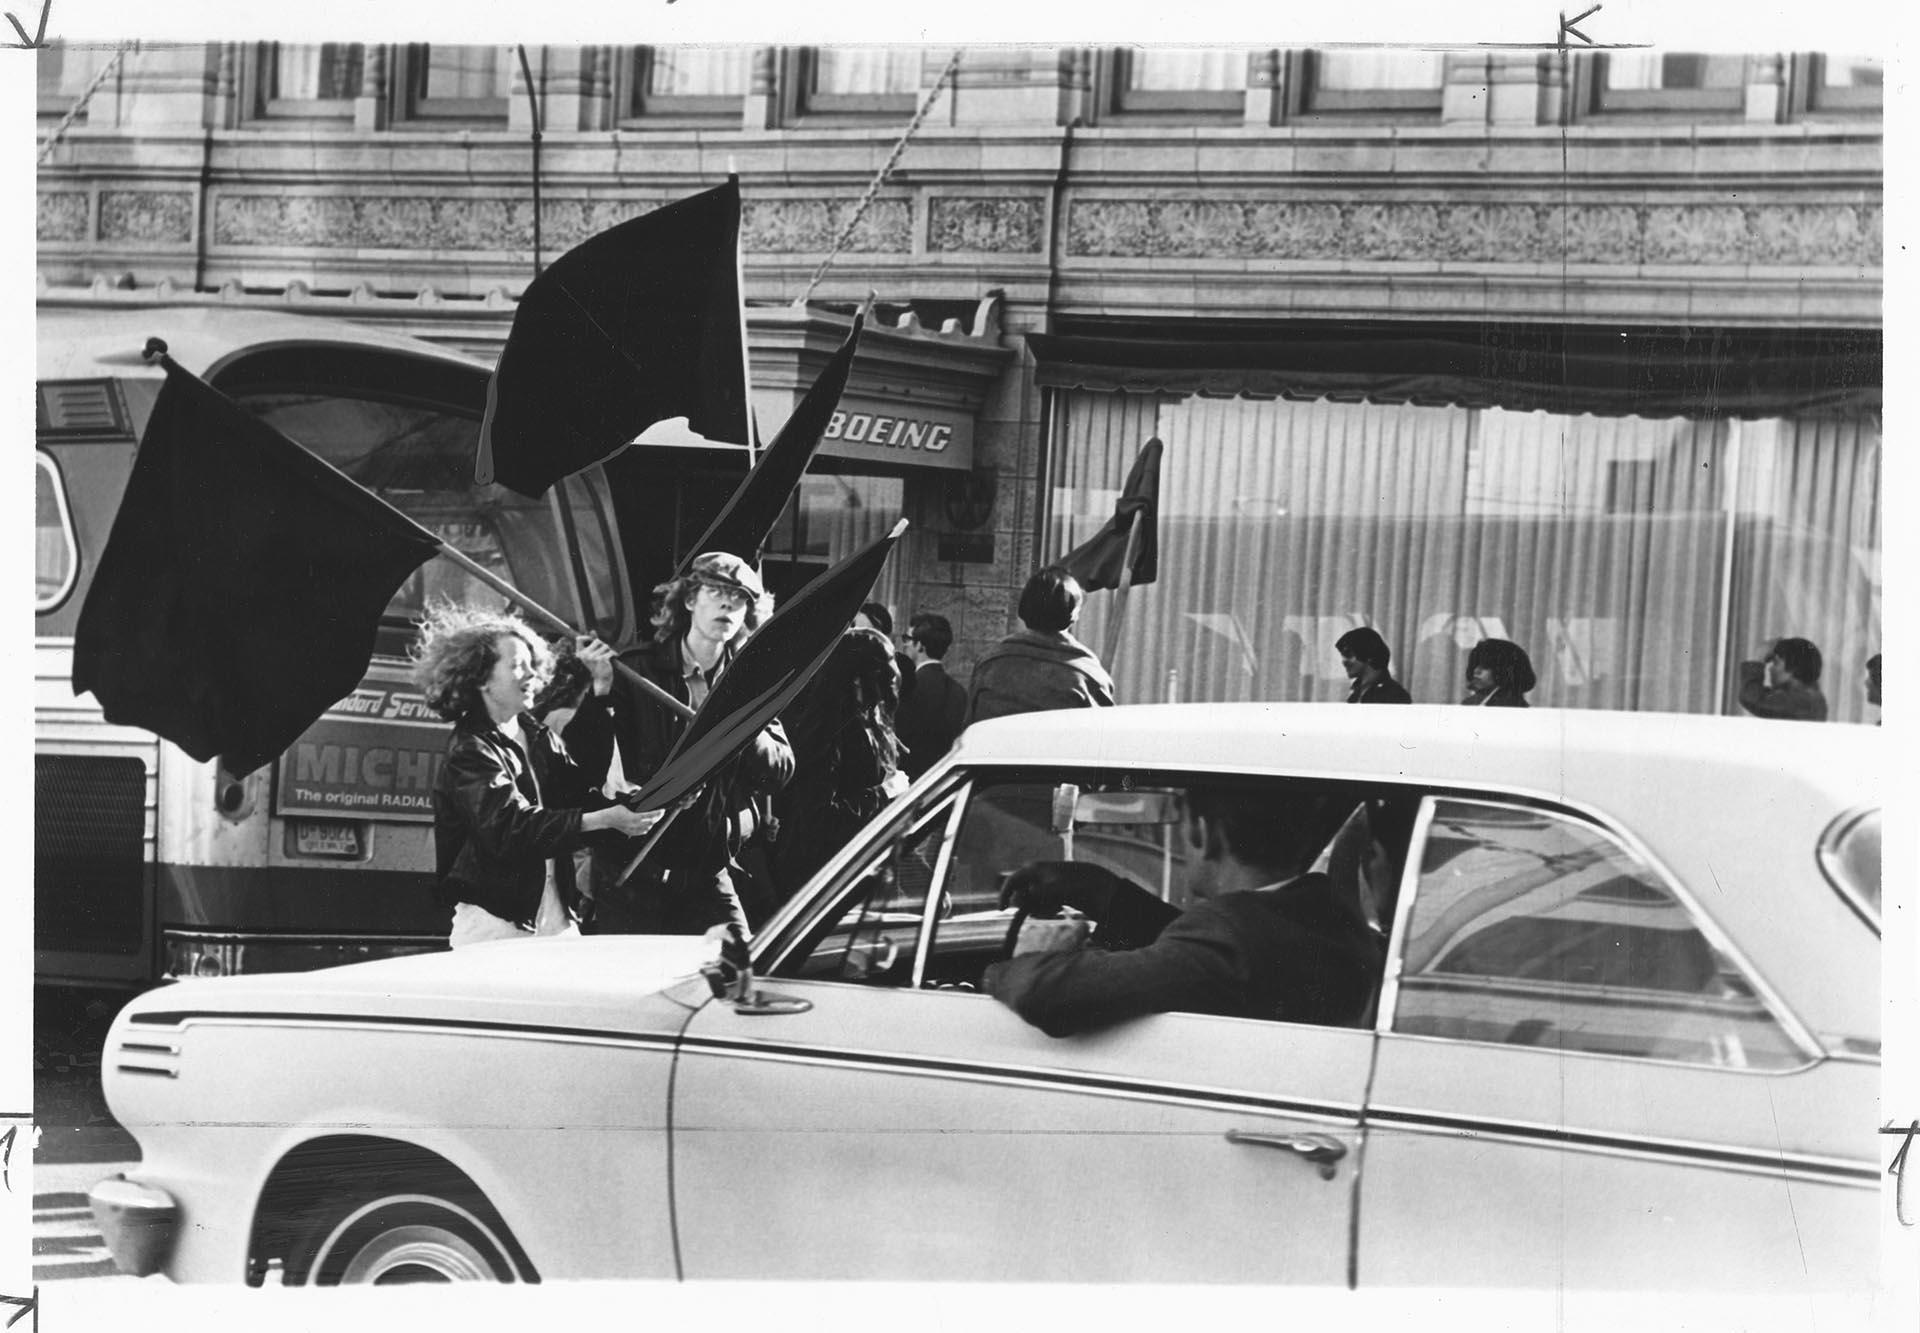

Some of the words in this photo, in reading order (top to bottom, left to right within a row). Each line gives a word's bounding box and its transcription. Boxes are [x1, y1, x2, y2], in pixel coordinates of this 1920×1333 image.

[824, 411, 952, 451] BOEING
[295, 788, 322, 802] The
[325, 791, 379, 806] original
[381, 793, 433, 809] RADIAL
